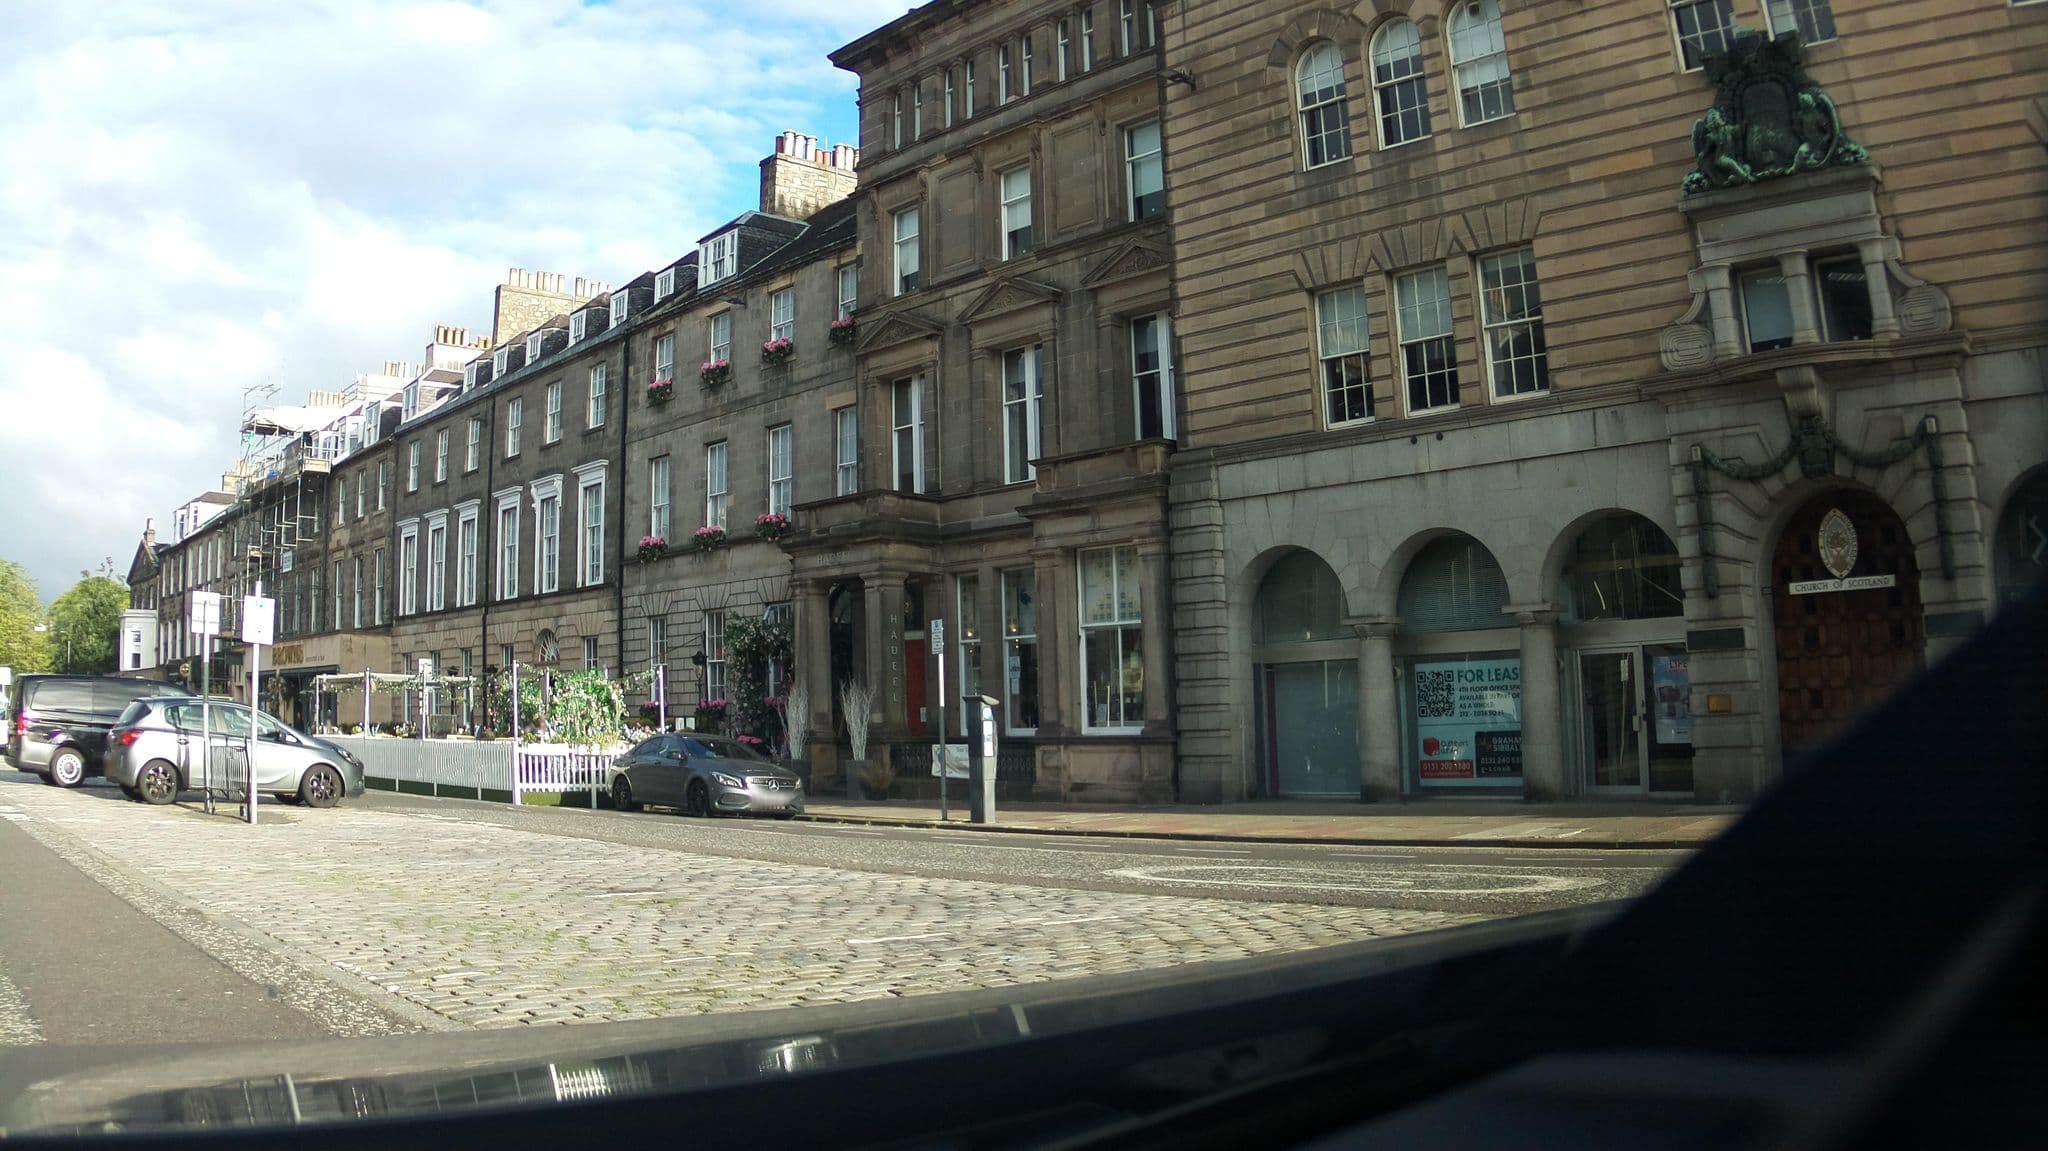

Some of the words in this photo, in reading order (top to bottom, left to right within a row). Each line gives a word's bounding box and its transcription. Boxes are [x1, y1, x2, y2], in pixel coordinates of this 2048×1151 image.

[1795, 582, 1828, 592] CHURCH
[1832, 579, 1843, 589] OF
[1848, 577, 1890, 588] SCOTLAND
[1457, 669, 1484, 683] FOR
[1487, 666, 1520, 682] LEAS
